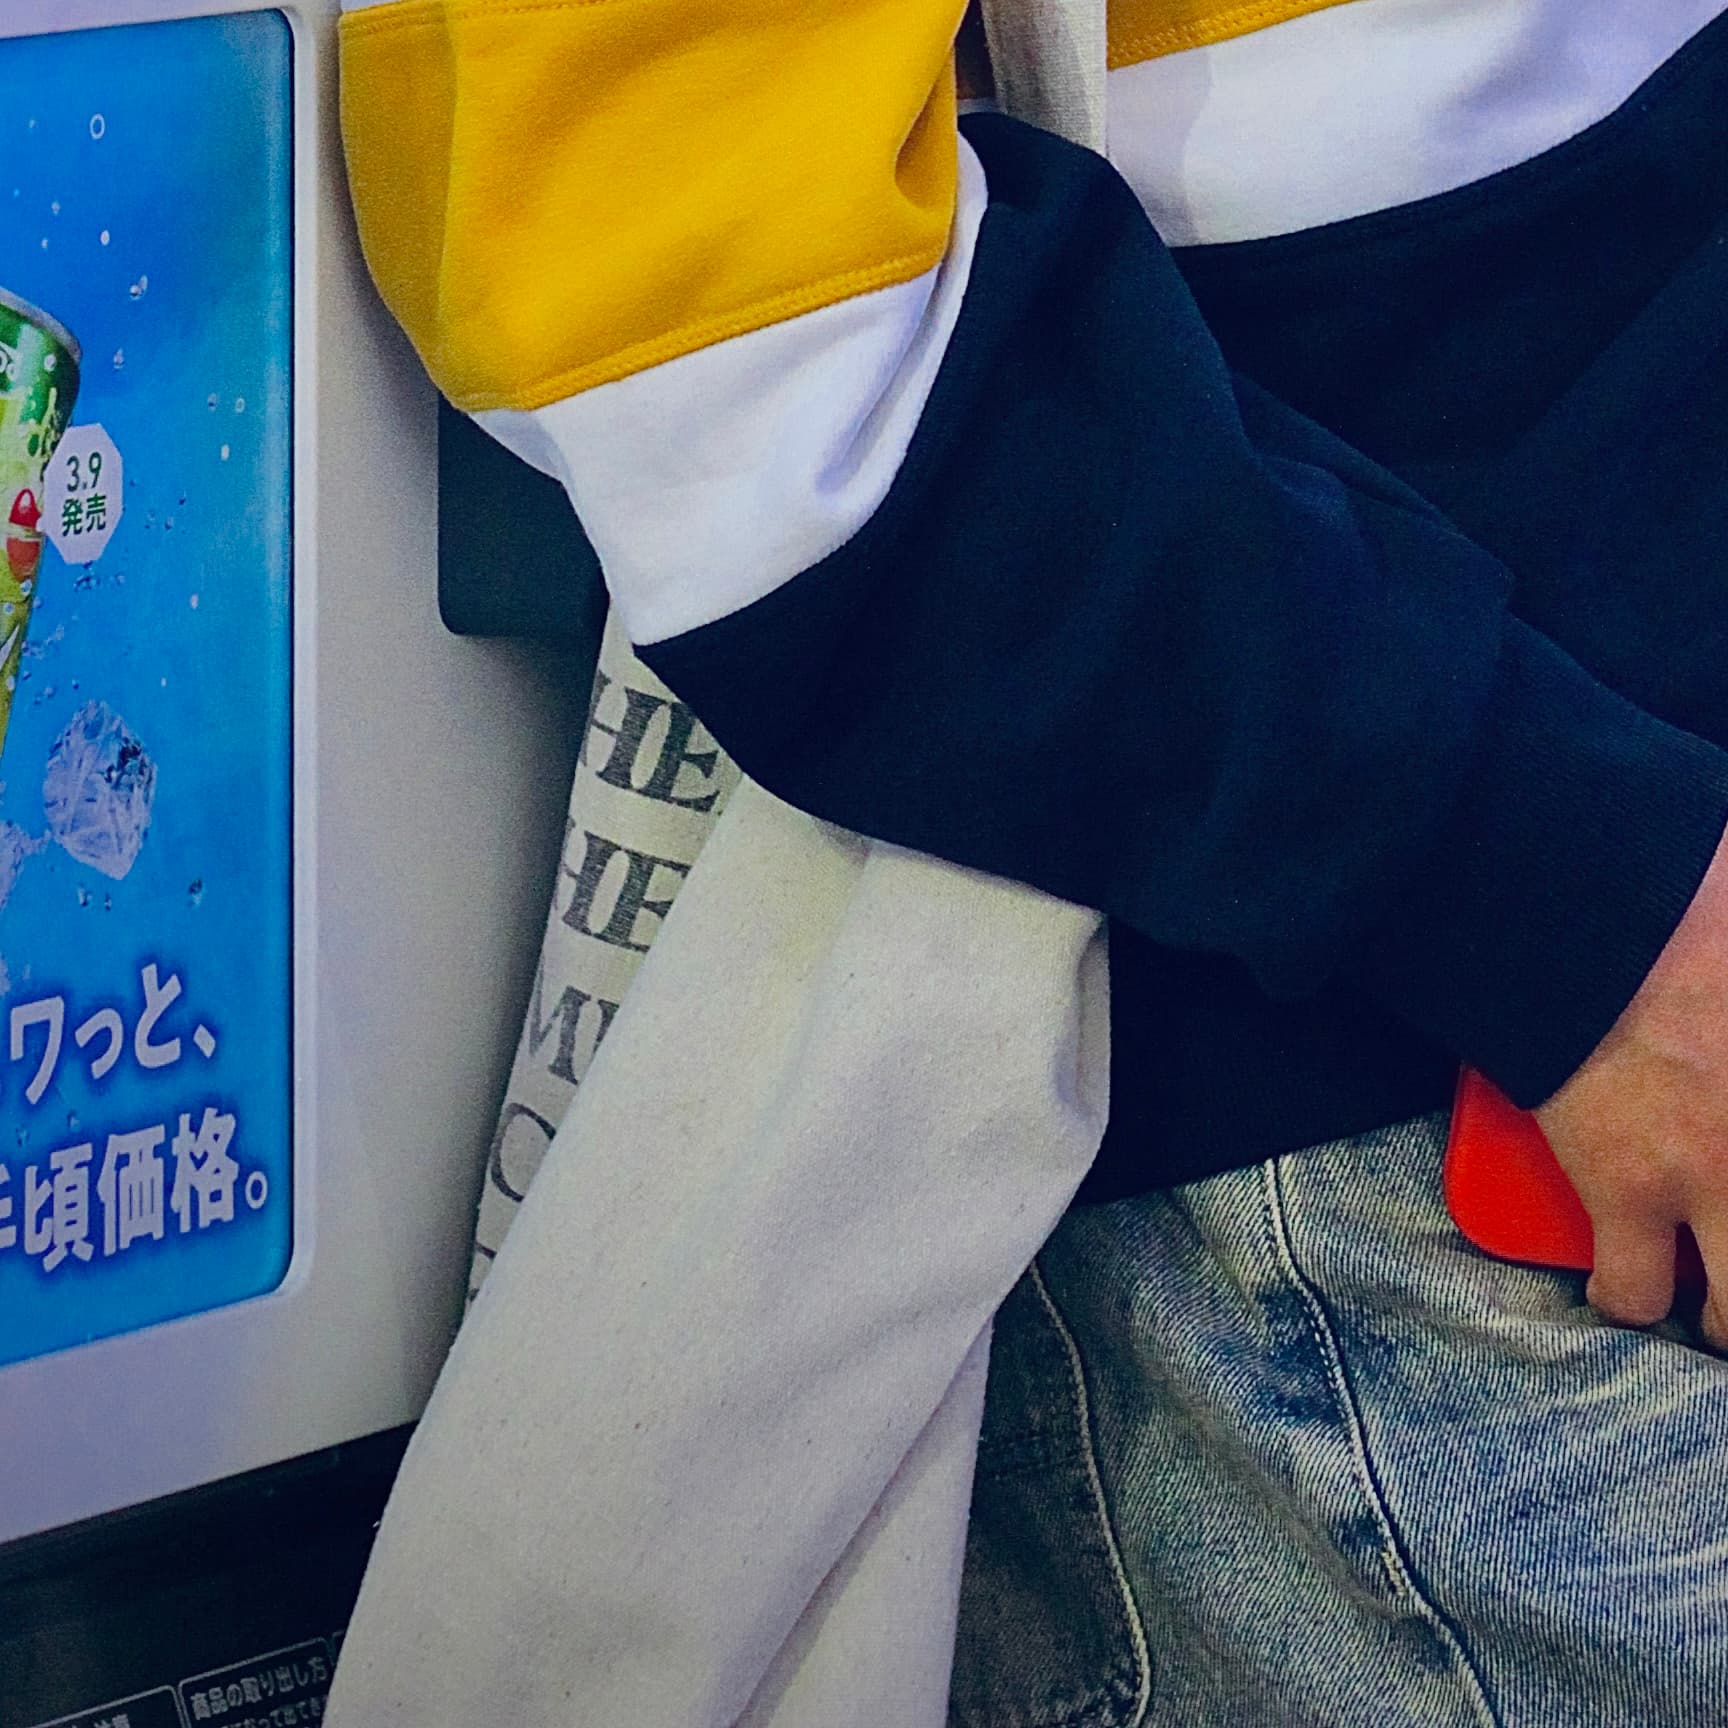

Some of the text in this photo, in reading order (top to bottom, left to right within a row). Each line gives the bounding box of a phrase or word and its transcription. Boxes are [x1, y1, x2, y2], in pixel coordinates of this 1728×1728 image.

[66, 451, 101, 492] 3.9
[61, 494, 107, 537] 発売
[10, 963, 216, 1105] ワっと、
